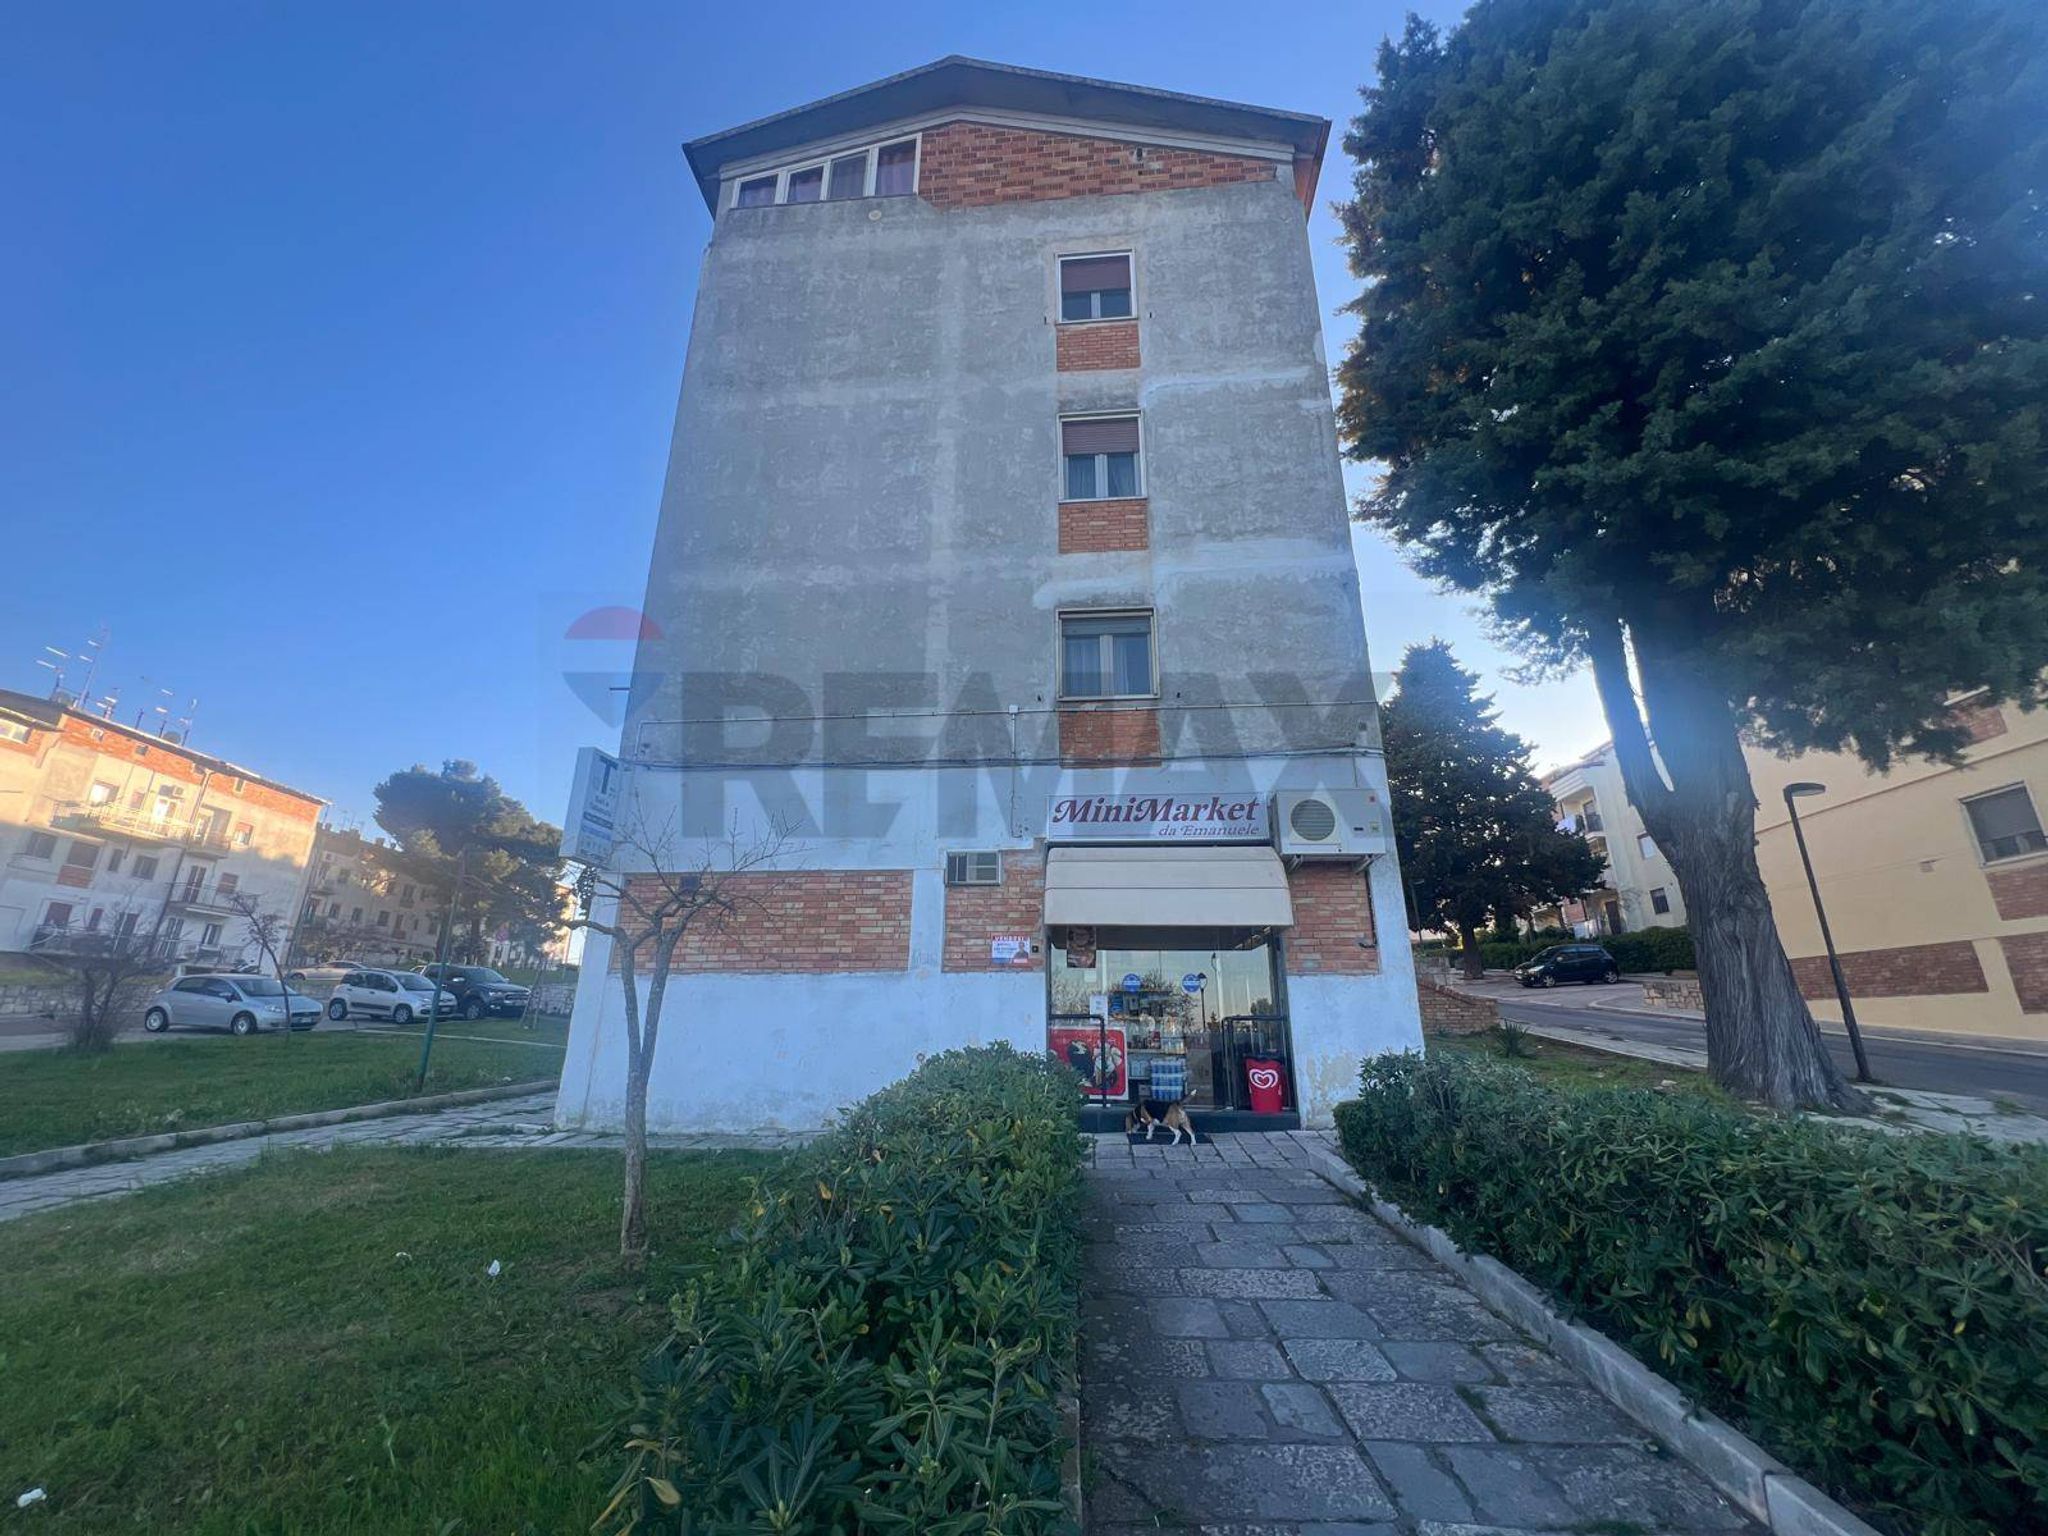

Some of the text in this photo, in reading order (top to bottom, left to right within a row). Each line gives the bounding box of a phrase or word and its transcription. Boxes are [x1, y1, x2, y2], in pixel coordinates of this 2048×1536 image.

[599, 755, 618, 794] T
[1052, 797, 1259, 823] MiniMarket
[1158, 825, 1260, 836] da Emanuele
